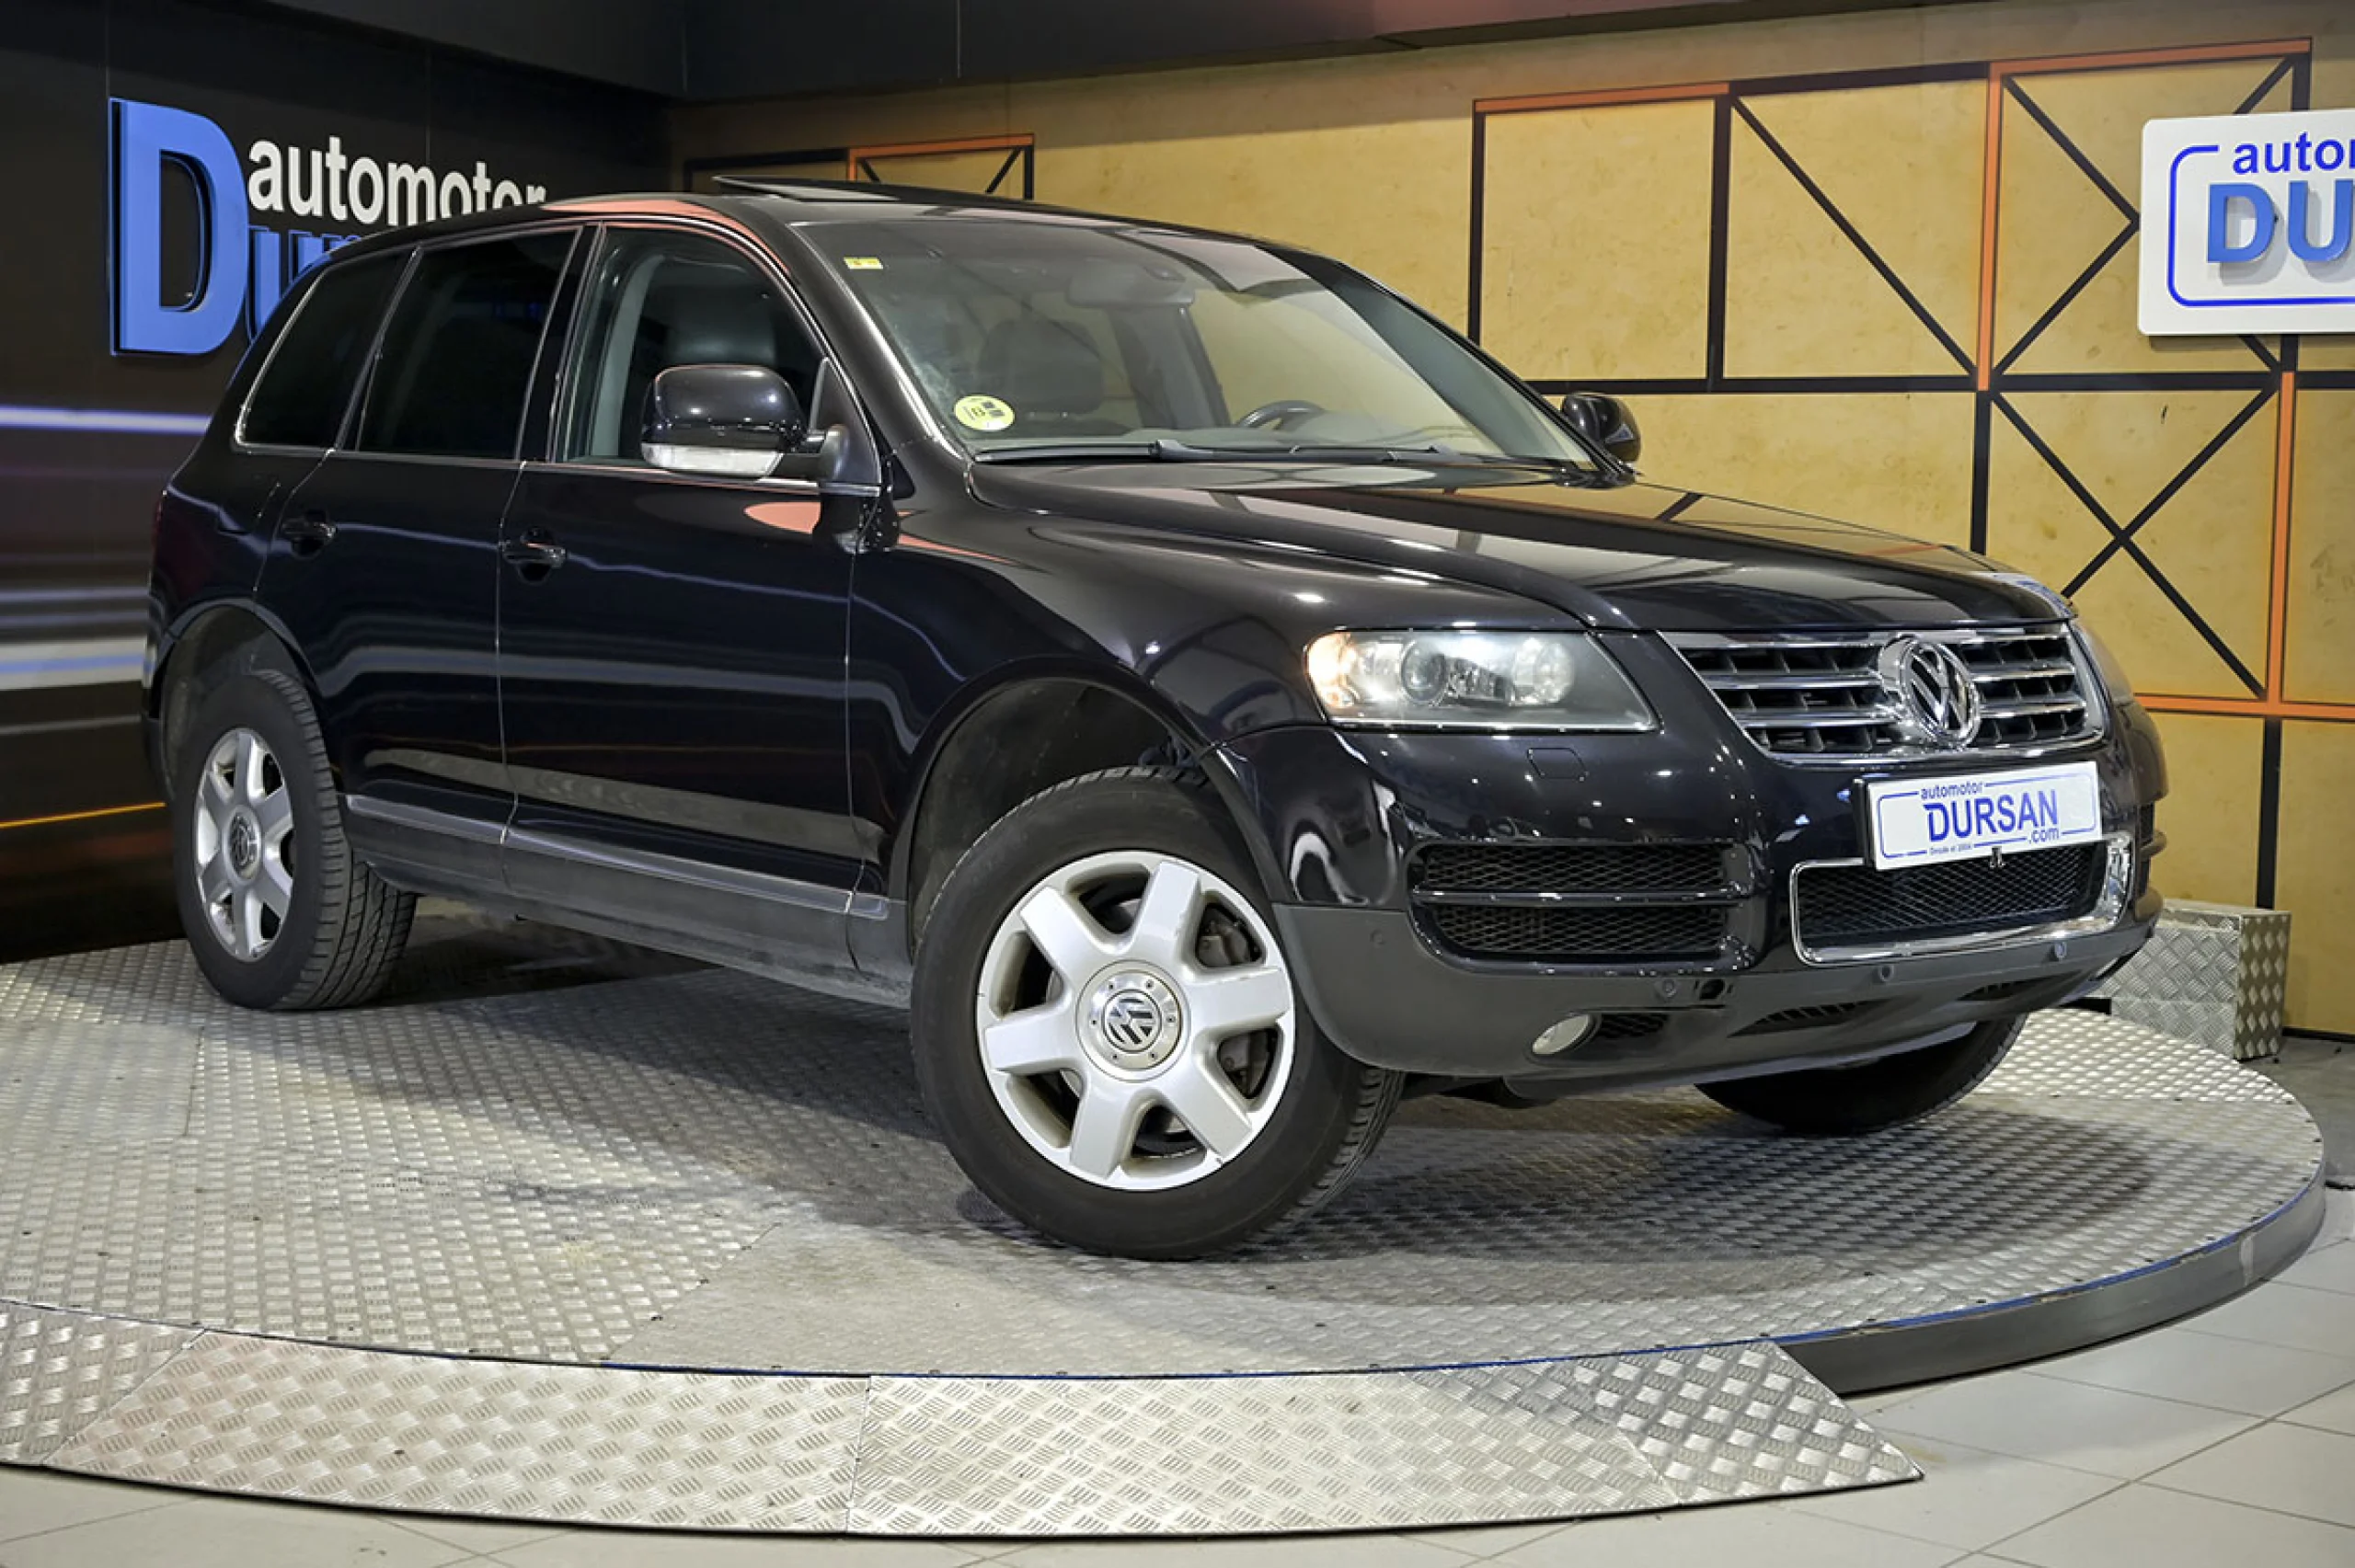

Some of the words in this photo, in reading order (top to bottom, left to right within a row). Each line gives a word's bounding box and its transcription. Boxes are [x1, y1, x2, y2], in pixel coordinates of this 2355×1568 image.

[2232, 132, 2355, 175] auto
[1920, 780, 1984, 800] automotor
[1922, 788, 2059, 843] DURSAN
[2028, 827, 2060, 844] .com
